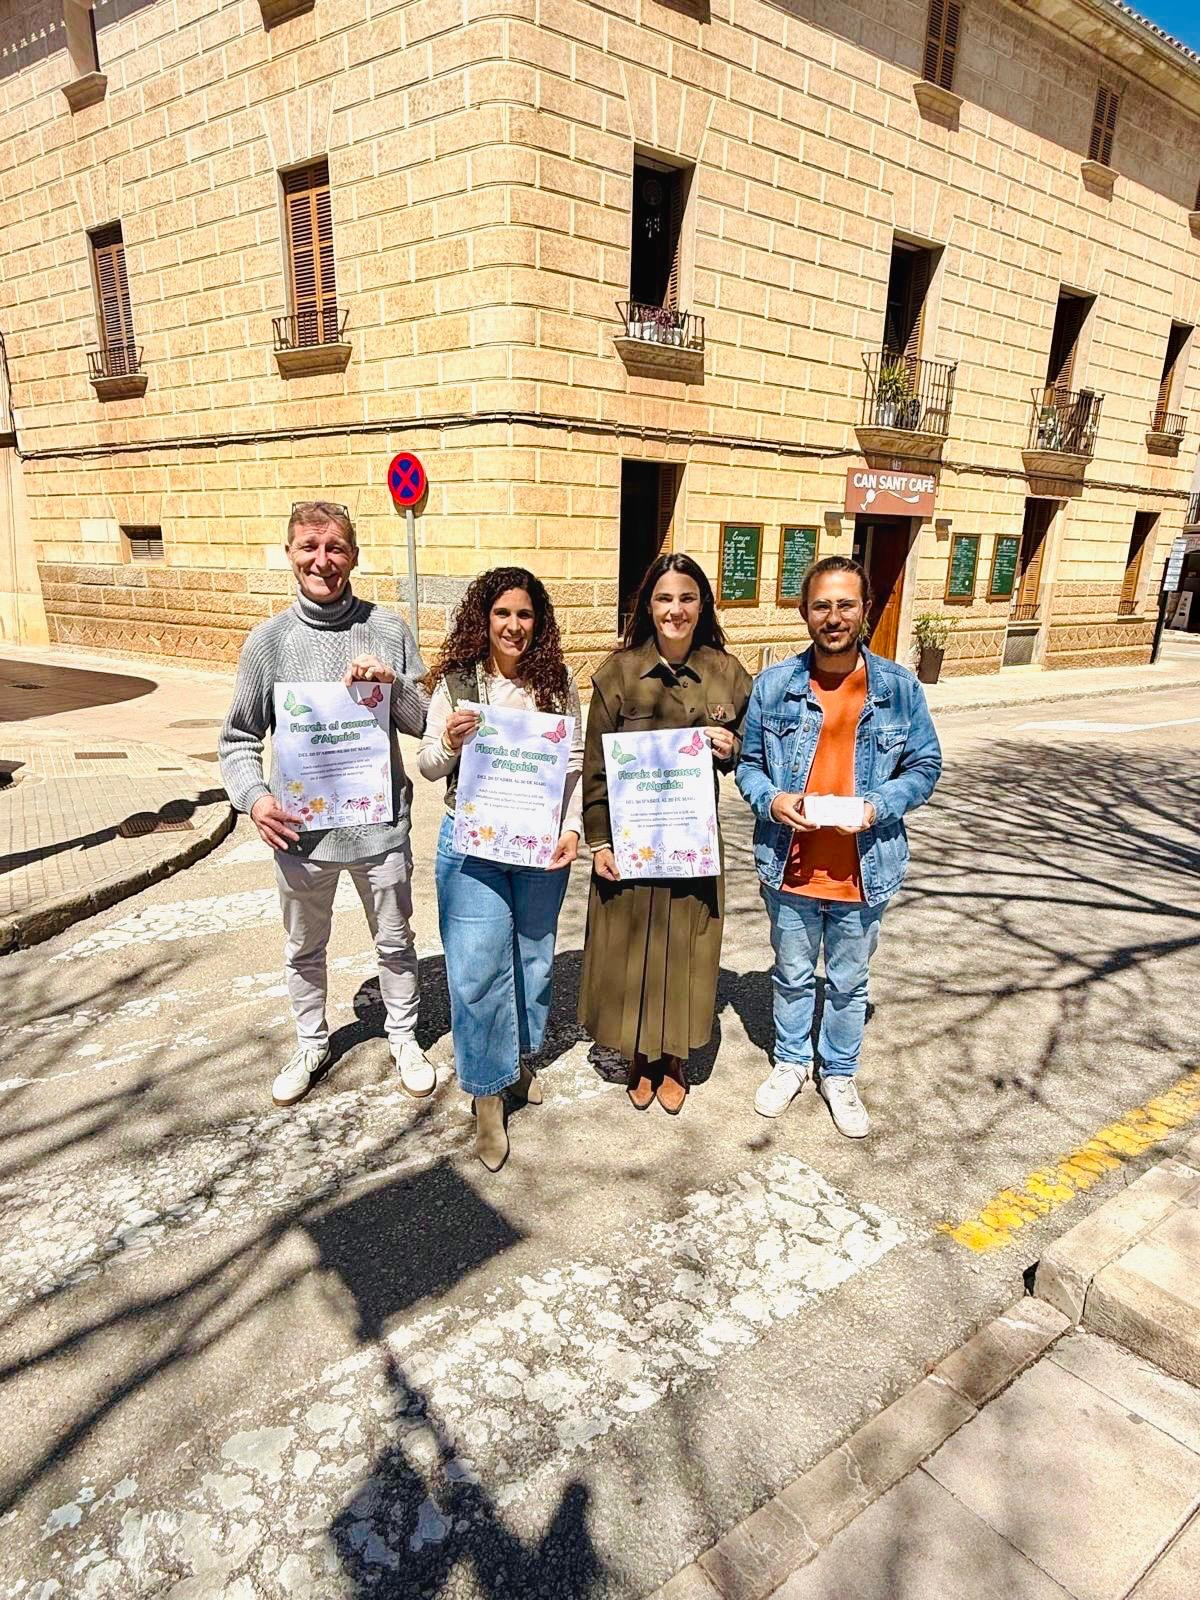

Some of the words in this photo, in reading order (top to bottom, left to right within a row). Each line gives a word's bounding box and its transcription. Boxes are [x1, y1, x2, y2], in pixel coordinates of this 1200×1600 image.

[853, 472, 877, 488] CAN
[878, 475, 907, 491] SANT
[908, 475, 934, 493] CAFÈ
